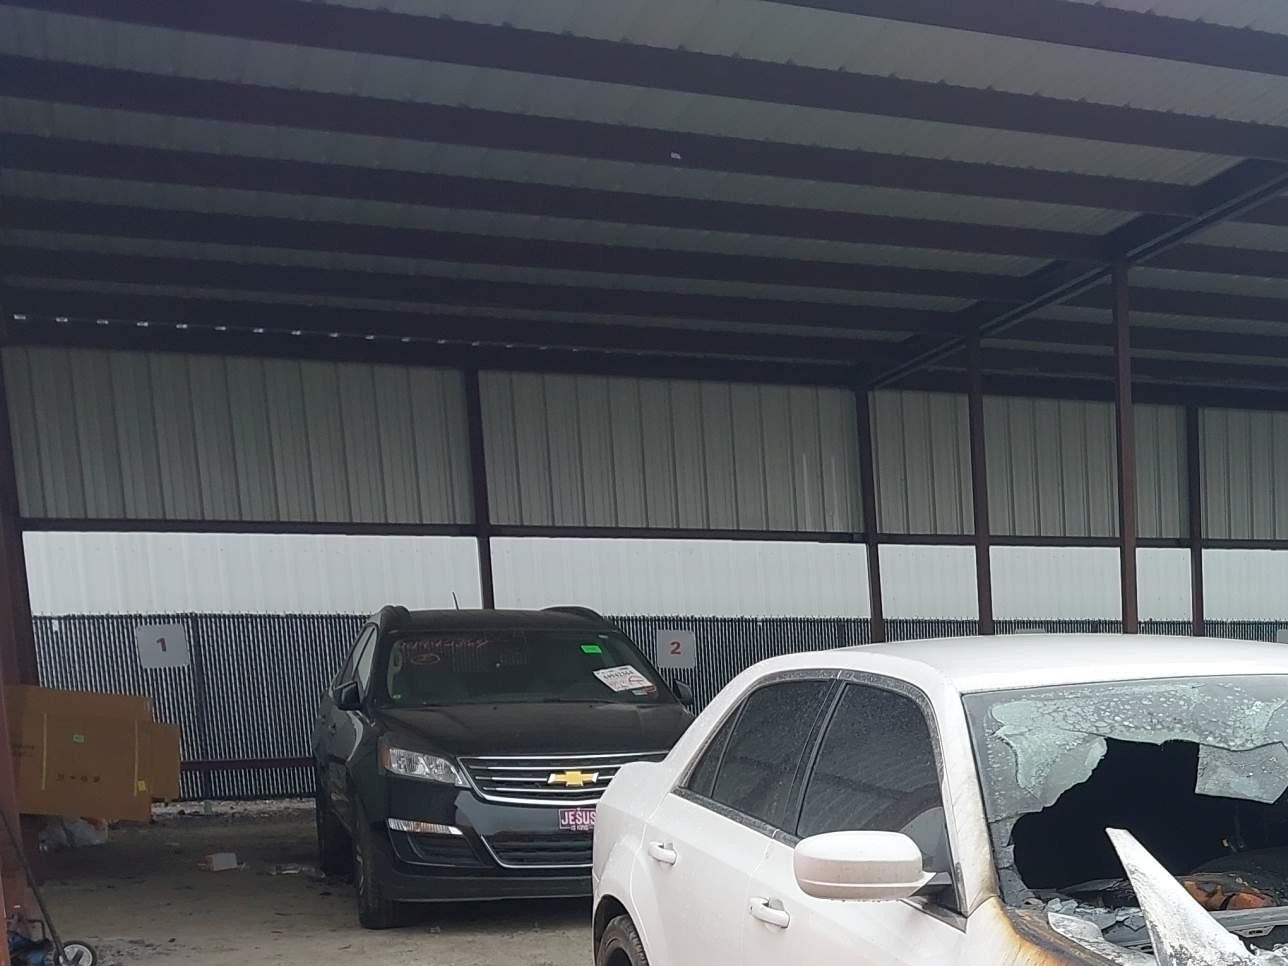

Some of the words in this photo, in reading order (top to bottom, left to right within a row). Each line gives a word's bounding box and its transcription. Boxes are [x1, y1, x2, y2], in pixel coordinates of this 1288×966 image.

[156, 637, 167, 652] 1
[670, 641, 681, 655] 2
[561, 811, 597, 825] JESUS
